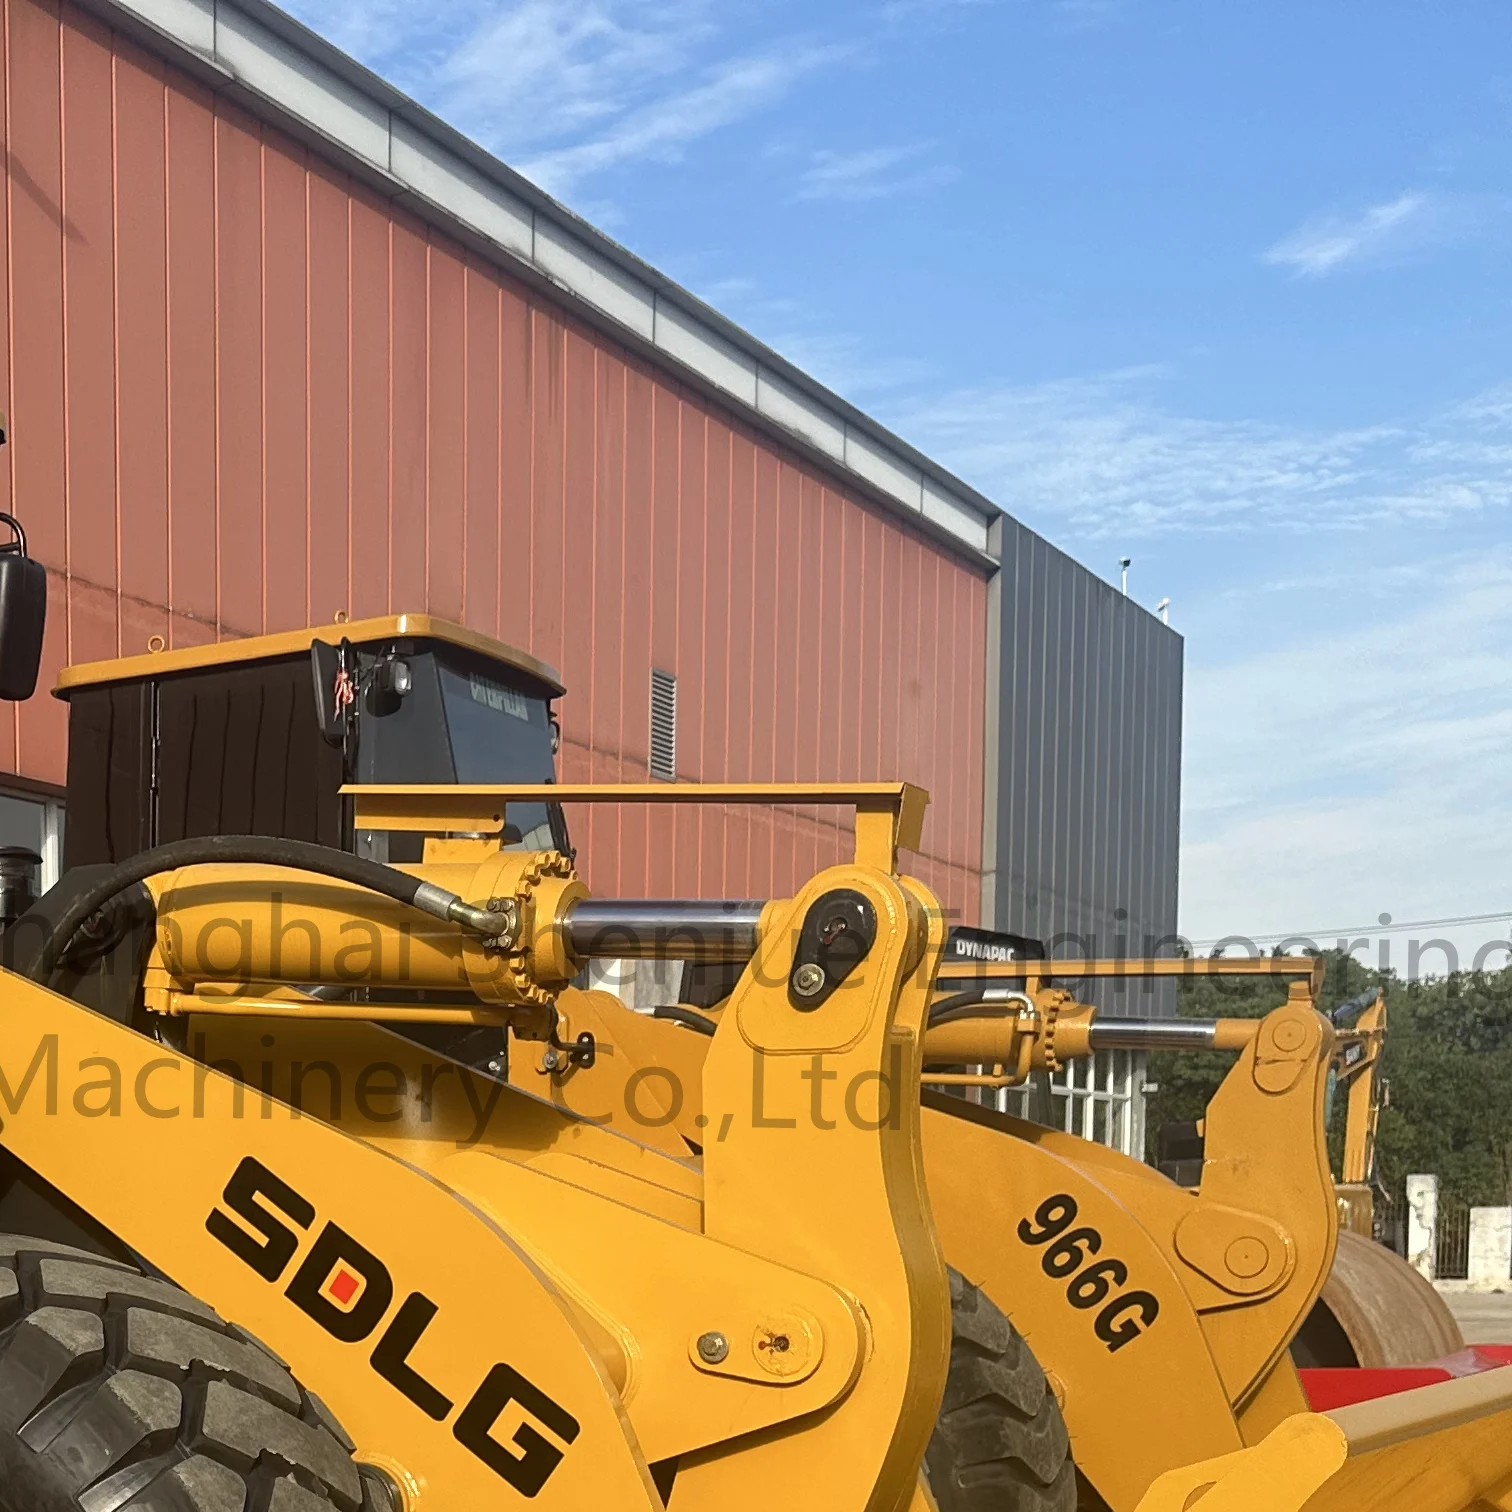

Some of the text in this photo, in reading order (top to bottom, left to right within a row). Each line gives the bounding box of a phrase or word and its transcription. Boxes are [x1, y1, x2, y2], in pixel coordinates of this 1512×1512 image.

[955, 939, 1015, 962] DYNAPAC
[205, 1155, 581, 1499] SDLG
[1017, 1193, 1160, 1354] 966G
